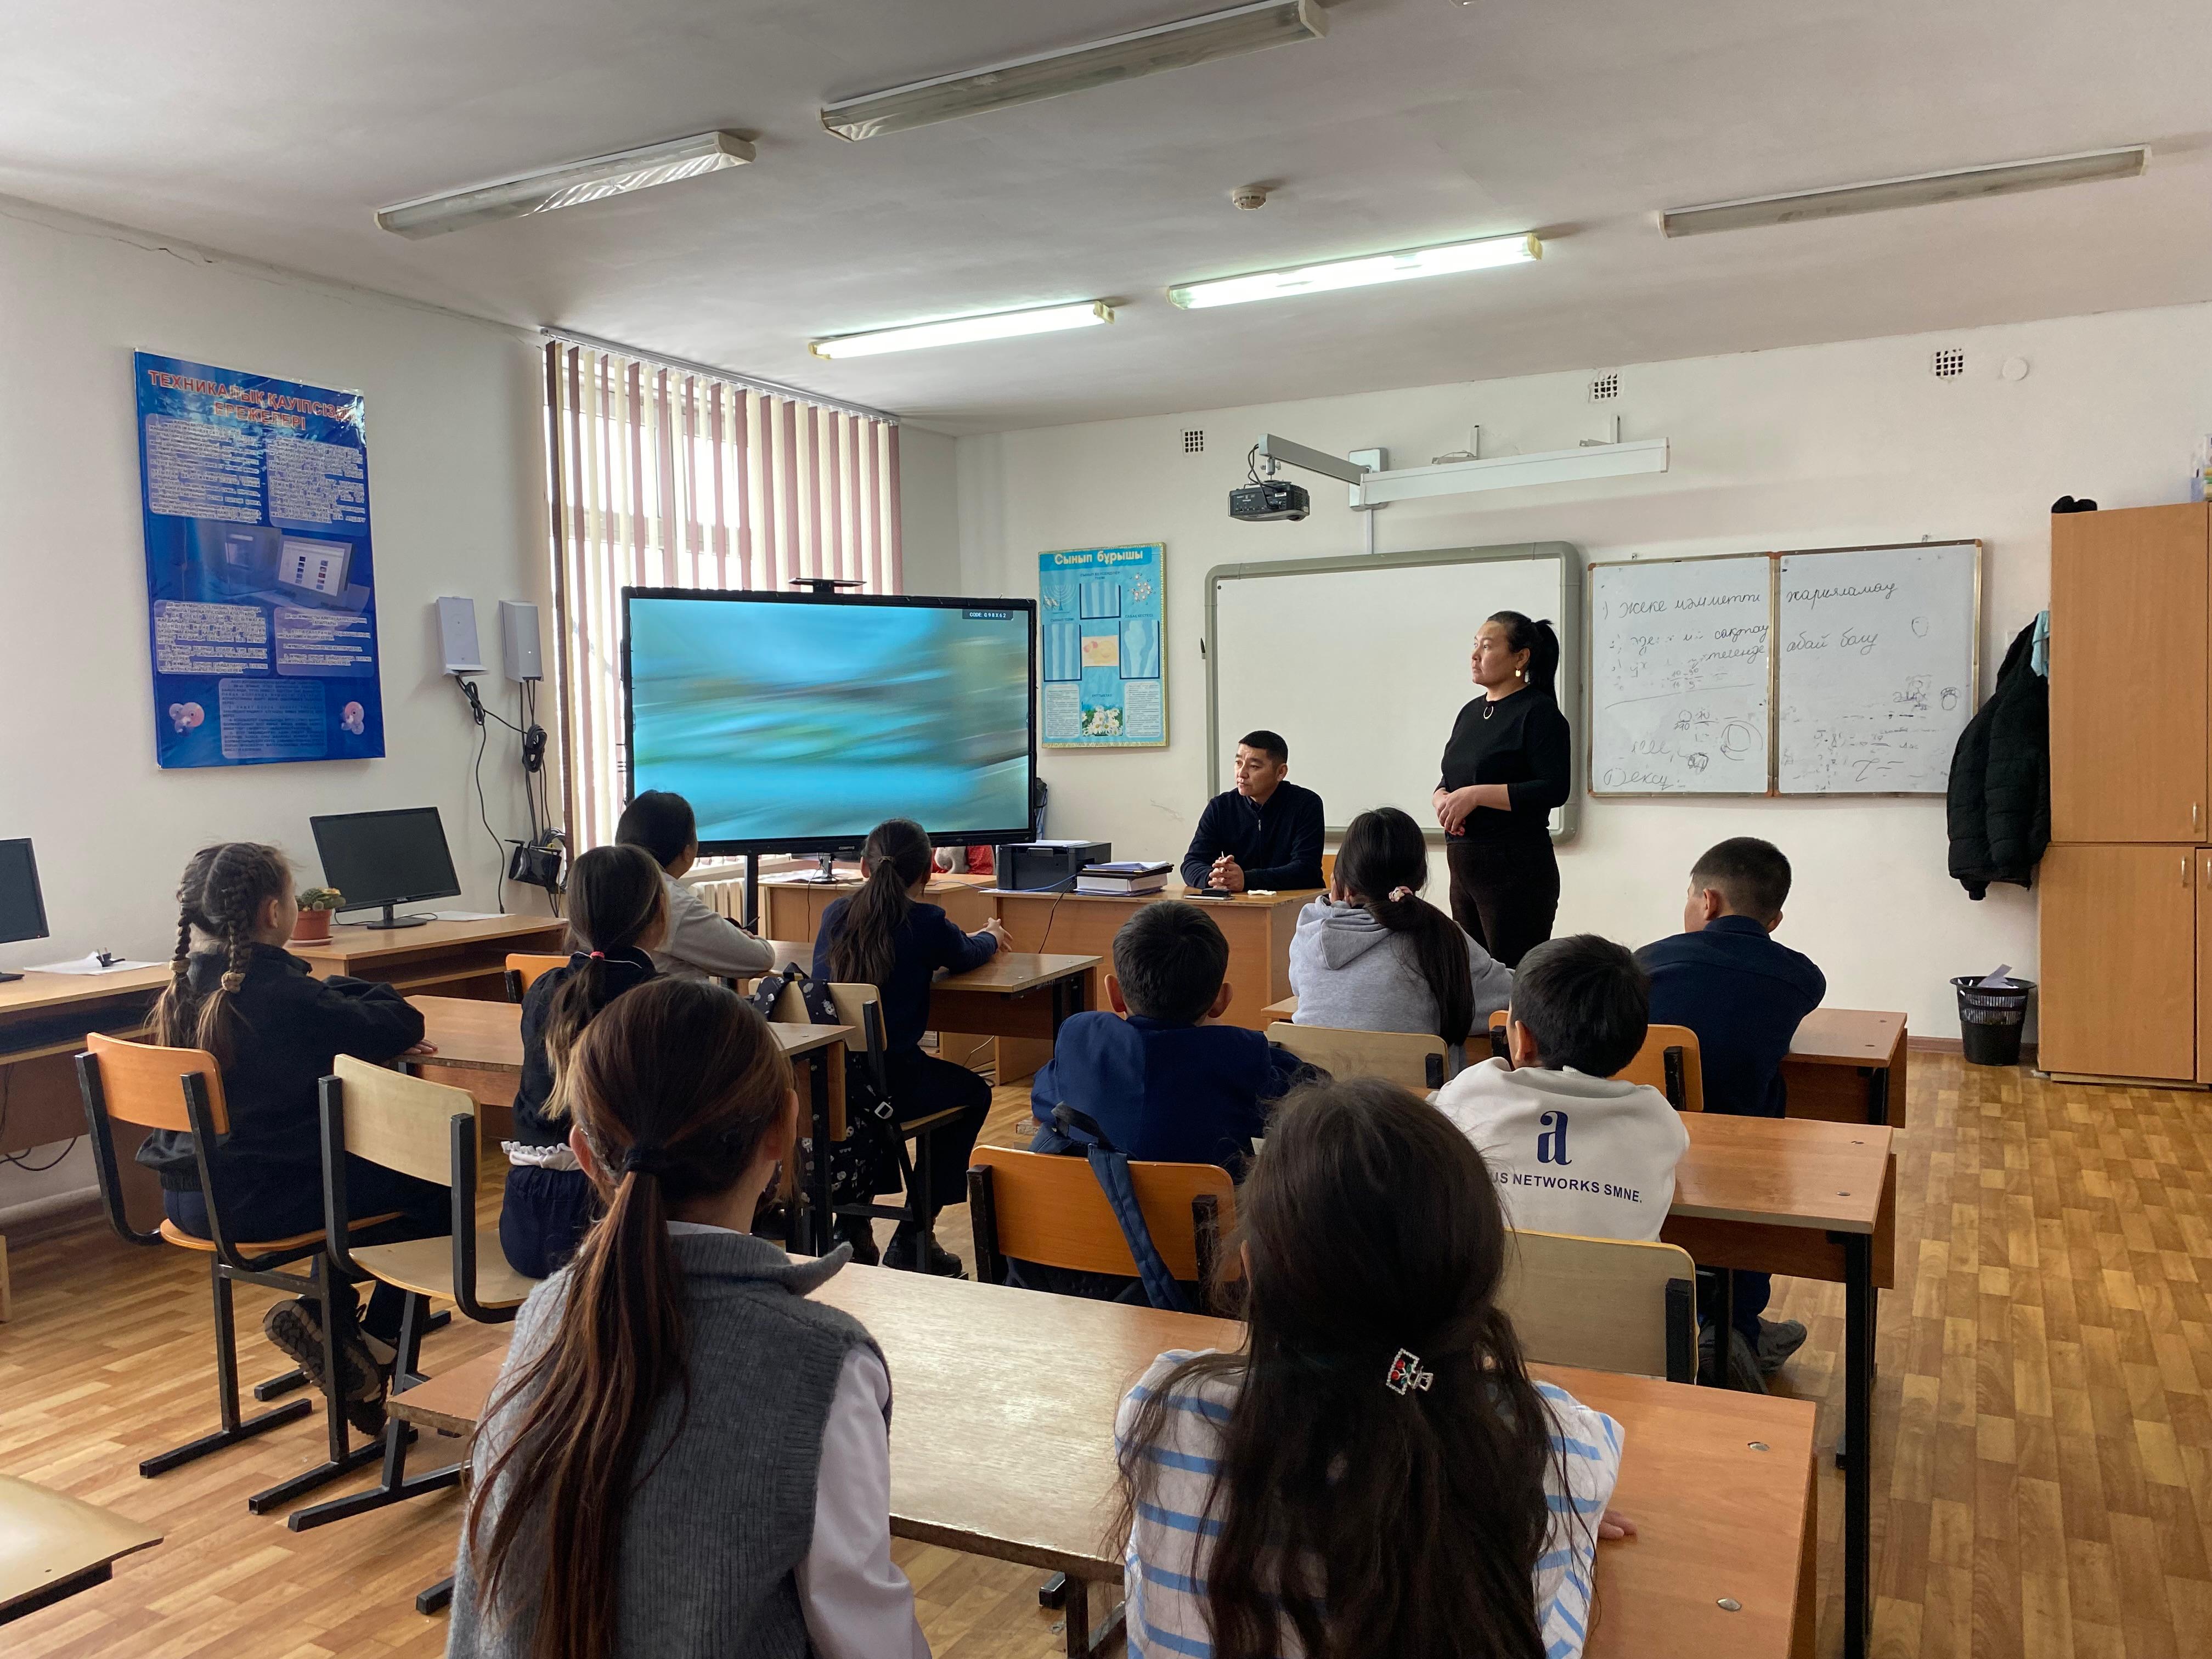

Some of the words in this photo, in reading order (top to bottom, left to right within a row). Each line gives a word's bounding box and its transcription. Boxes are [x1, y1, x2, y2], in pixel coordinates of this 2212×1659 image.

[215, 402, 306, 430] ЕРЕЖЕЛЕРІ
[1054, 553, 1092, 566] Сынып
[1097, 549, 1143, 566] бұрышы
[1537, 1110, 1572, 1165] a
[1513, 1173, 1600, 1193] NETWORKS
[1604, 1183, 1643, 1203] SMNE.
